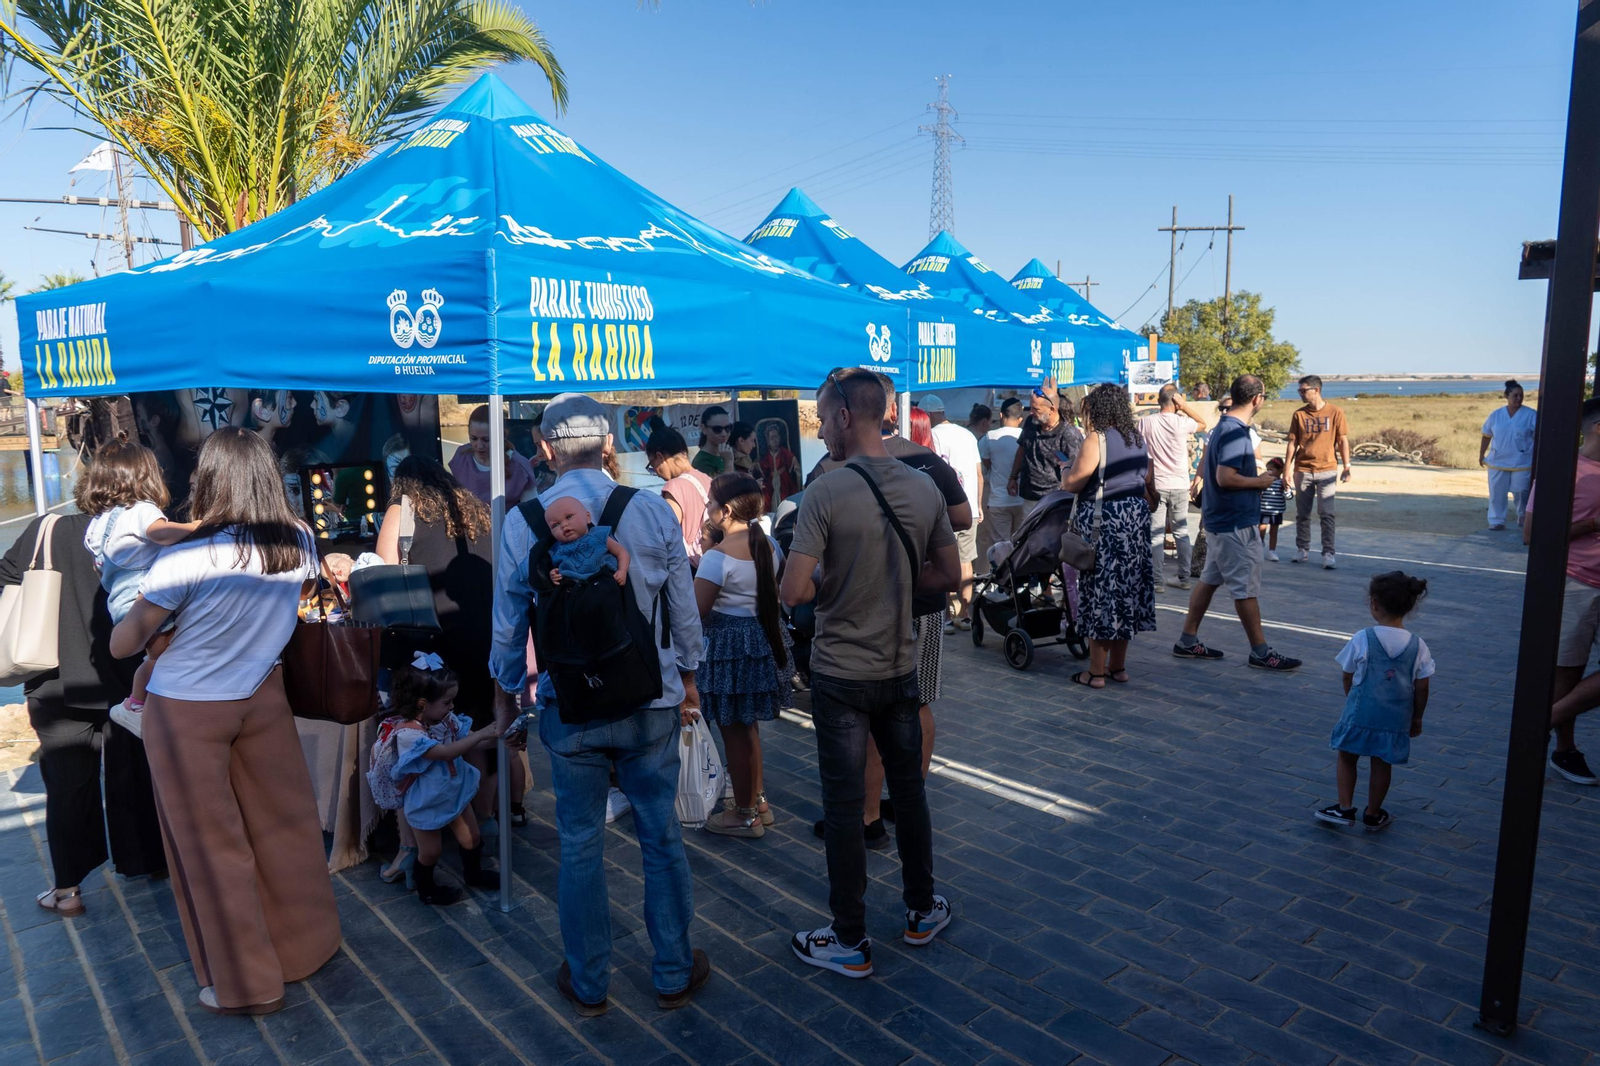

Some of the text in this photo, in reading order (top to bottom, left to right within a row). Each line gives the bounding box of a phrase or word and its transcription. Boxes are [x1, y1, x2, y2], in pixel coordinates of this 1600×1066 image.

[530, 272, 654, 321] PARAJE TURÍSTICO
[36, 302, 107, 341] PARAJE NATURAL
[35, 344, 58, 389] LA
[368, 354, 467, 365] DIPUTACIÓN PROVINCIAL
[402, 366, 435, 375] HUELVA
[531, 322, 565, 381] LA
